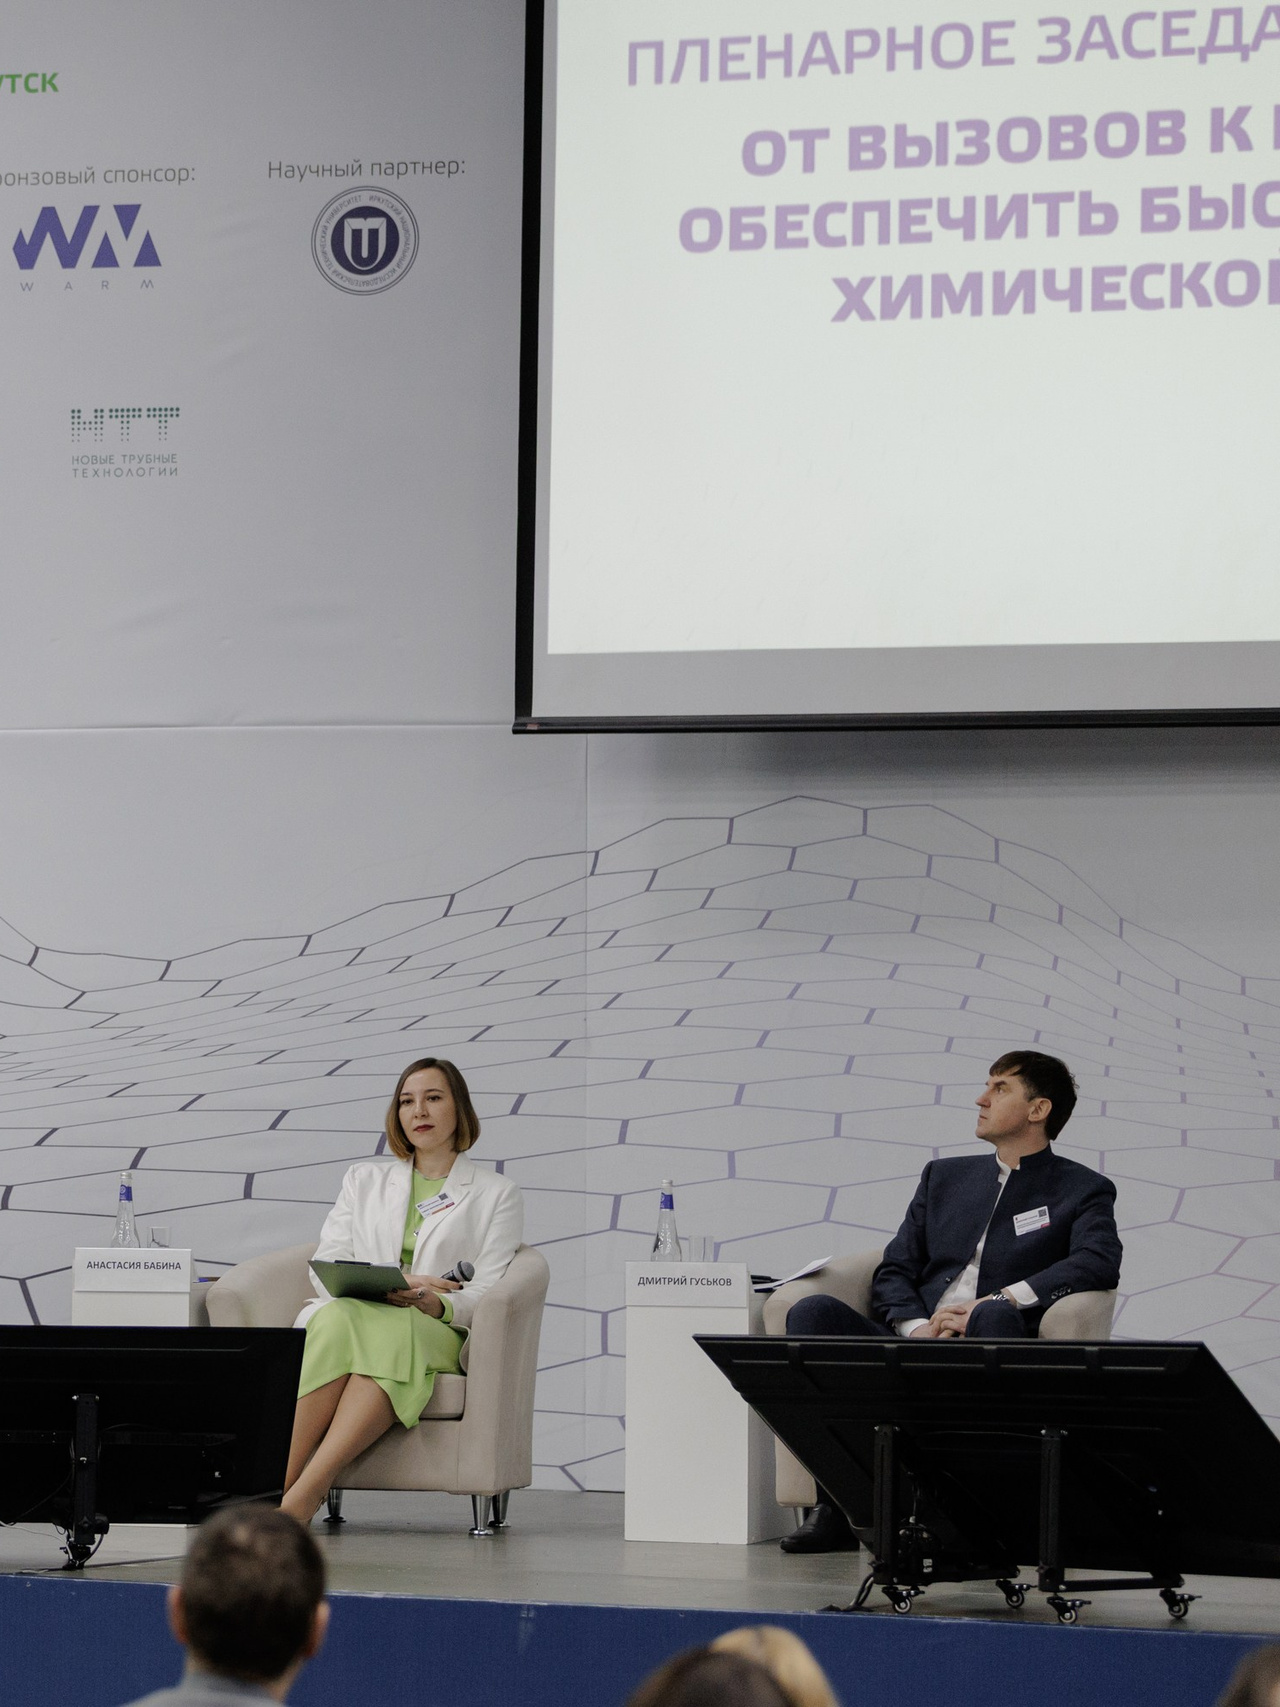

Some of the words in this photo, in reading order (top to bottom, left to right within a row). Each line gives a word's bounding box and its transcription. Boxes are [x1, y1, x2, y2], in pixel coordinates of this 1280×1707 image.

[627, 19, 1017, 87] ПЛЕНАРНОЕ
[1036, 3, 1280, 66] ЗАСЕДА
[741, 127, 831, 178] ОТ
[847, 108, 1187, 172] ВЫЗОВОВ
[1209, 104, 1254, 154] К
[102, 166, 196, 186] спонсор:
[267, 158, 363, 183] Научный
[369, 159, 466, 180] партнер:
[678, 189, 1120, 254] ОБЕСПЕЧИТЬ
[831, 246, 1280, 322] ХИМИЧЕСКО
[71, 454, 115, 465] НОВЫЕ
[121, 453, 178, 465] ТРУБНЫЕ
[72, 466, 179, 479] ТЕХНОЛОГИИ
[85, 1260, 142, 1270] АНАСТАСИЯ
[142, 1260, 182, 1271] БАБИНА
[636, 1275, 688, 1287] ДМИТРИЙ
[688, 1276, 733, 1287] ГУСЬКОВ
